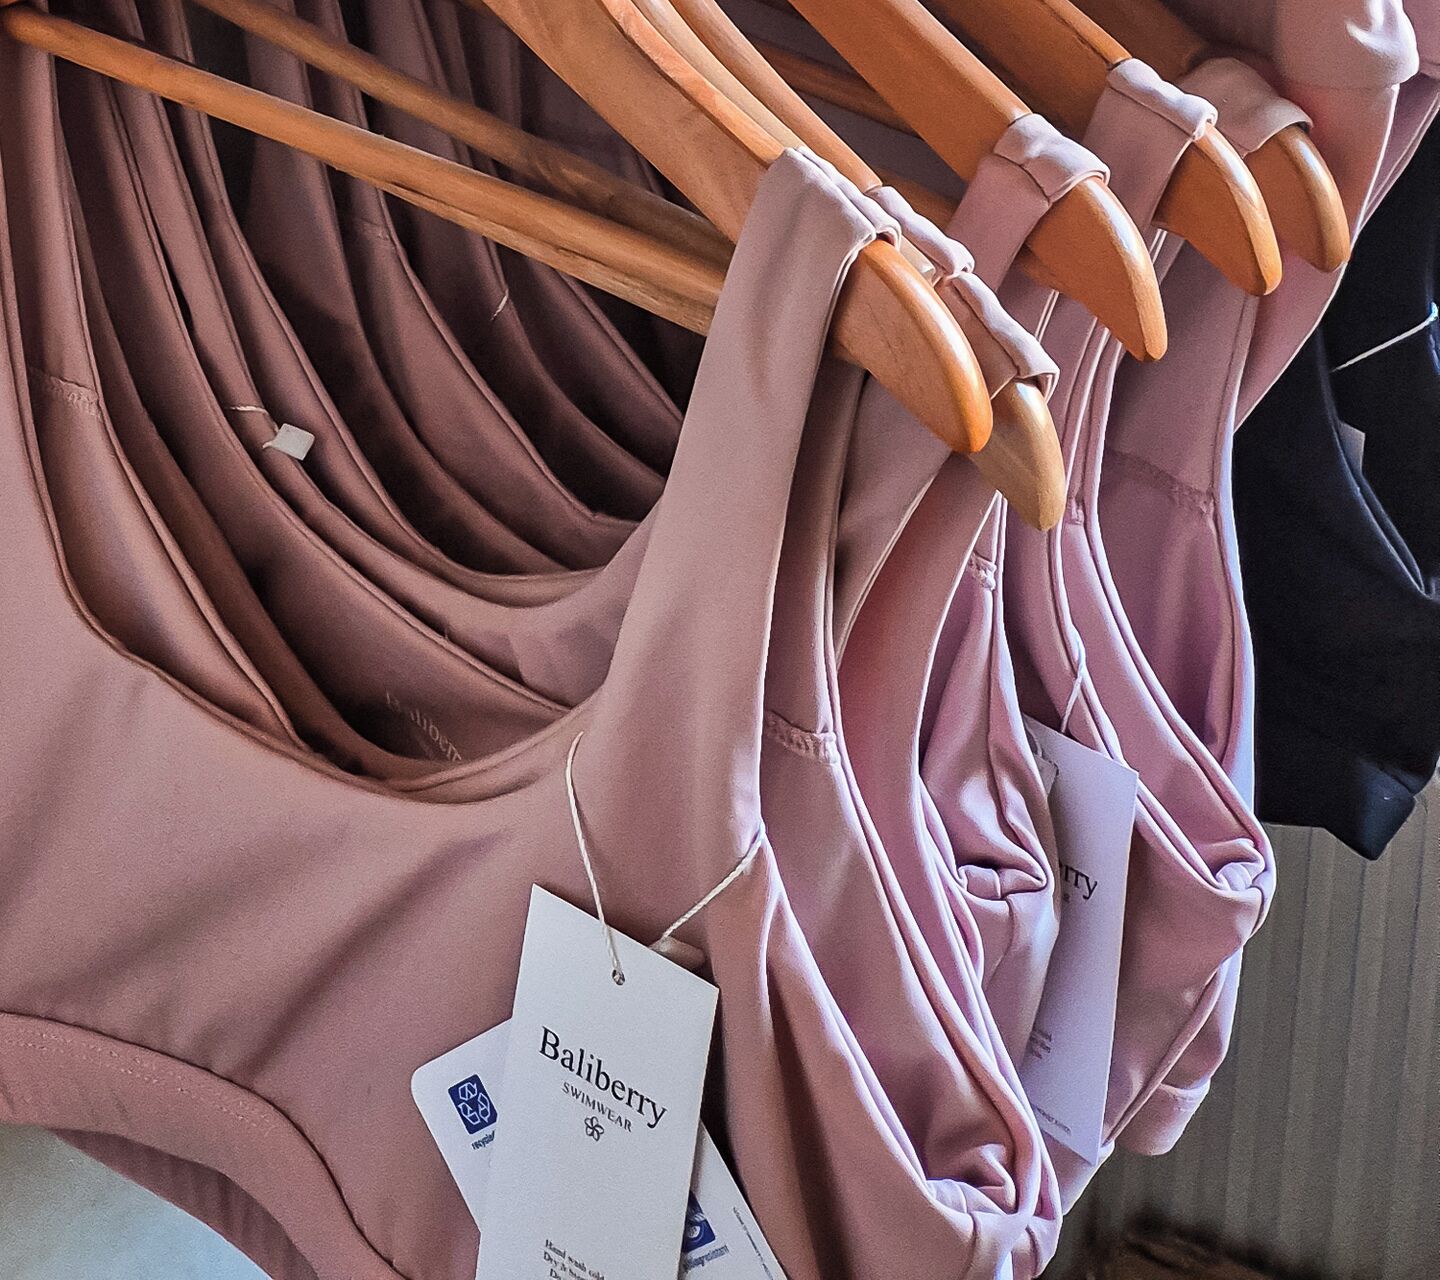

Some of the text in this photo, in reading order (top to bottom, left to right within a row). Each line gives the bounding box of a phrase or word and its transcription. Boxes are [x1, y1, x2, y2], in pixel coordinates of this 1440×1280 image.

[1060, 862, 1098, 901] rry
[539, 1025, 668, 1129] Baliberry
[562, 1081, 633, 1133] SWIMWEAR
[545, 1239, 566, 1259] Hand
